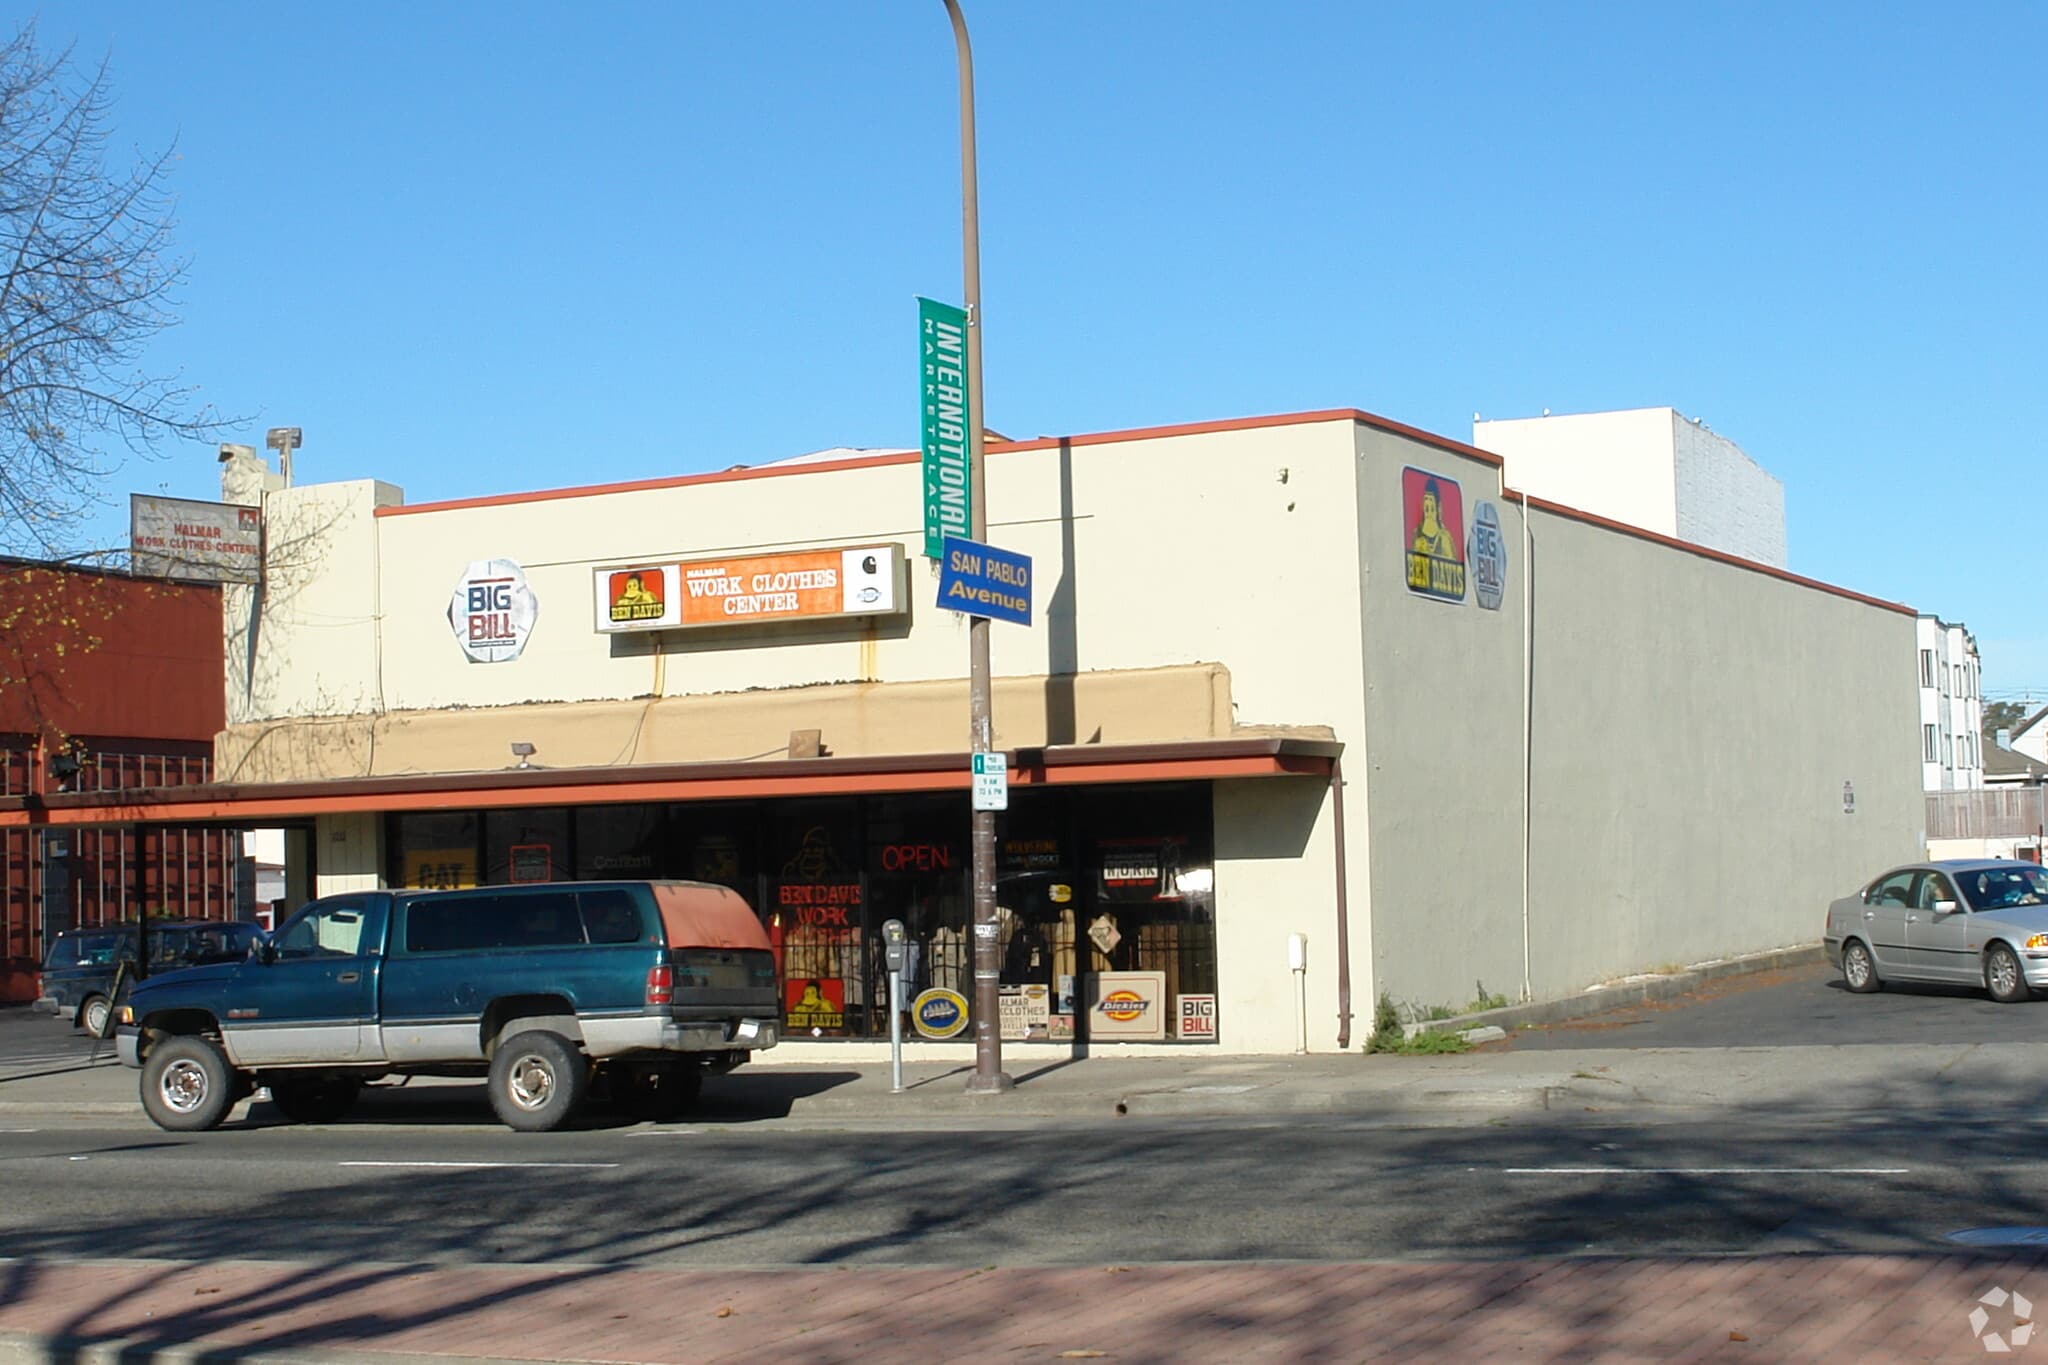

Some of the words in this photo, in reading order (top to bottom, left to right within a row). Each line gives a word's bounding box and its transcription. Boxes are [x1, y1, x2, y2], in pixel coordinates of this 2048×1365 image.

[925, 318, 938, 538] MARKETPLACE
[937, 321, 966, 540] INTERNATIONAL
[174, 523, 221, 538] HALMAR
[1477, 527, 1496, 558] BIG
[135, 535, 165, 547] WORK
[169, 537, 213, 552] CLOTHES
[951, 551, 980, 576] SAN
[986, 558, 1027, 588] PABLO
[1408, 553, 1430, 588] BEN
[1431, 559, 1463, 596] DAVIS
[1478, 556, 1499, 587] BILL
[687, 575, 743, 598] WORK
[752, 569, 837, 593] CLOTHES
[948, 580, 1027, 612] Avenue
[468, 585, 511, 613] BIG
[724, 592, 799, 615] CENTER
[611, 606, 631, 620] BEN
[633, 604, 663, 619] DAVIS
[468, 613, 516, 641] BILL
[881, 844, 950, 872] OPEN
[779, 885, 812, 905] BEN
[814, 885, 862, 905] DAVIS
[796, 906, 848, 927] WORK
[1000, 997, 1029, 1006] ALMAR
[1103, 1001, 1146, 1011] Dickies
[1182, 1002, 1213, 1017] BIG
[787, 1013, 808, 1027] BEN
[811, 1013, 843, 1027] DAVIS
[1182, 1018, 1213, 1033] BILL
